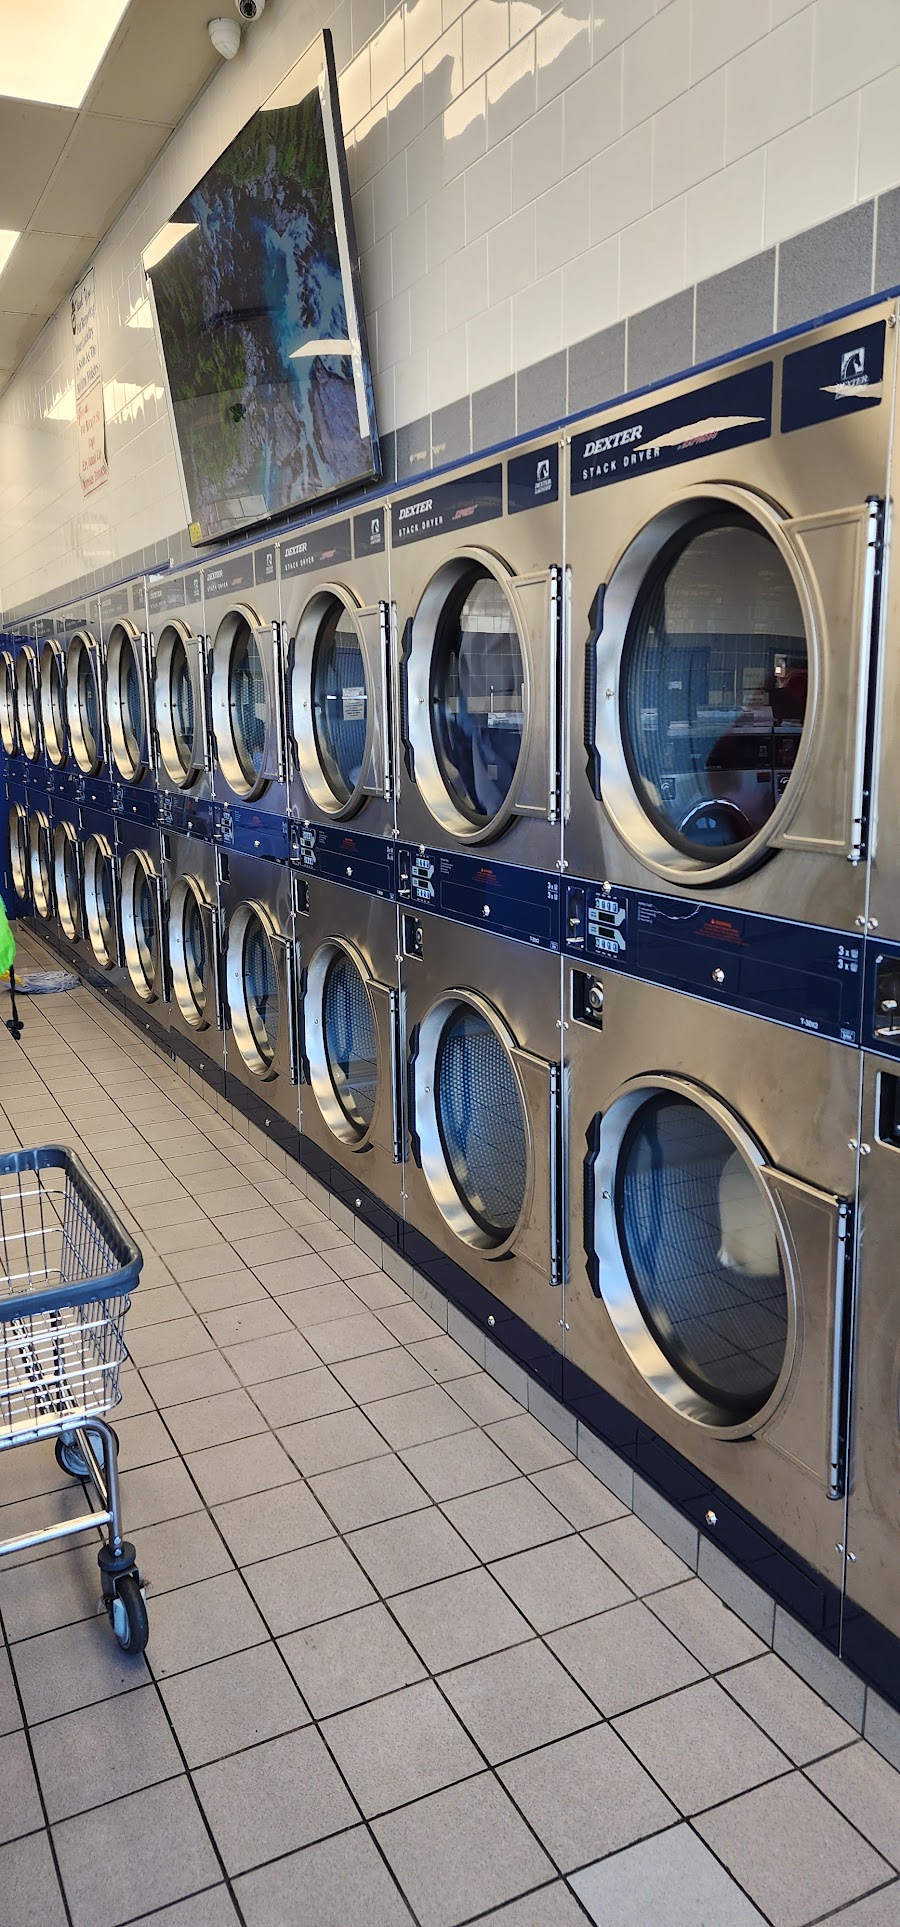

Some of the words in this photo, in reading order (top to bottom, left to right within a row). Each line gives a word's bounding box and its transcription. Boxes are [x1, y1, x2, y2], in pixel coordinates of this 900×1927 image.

[583, 425, 643, 458] DEXTER
[582, 460, 617, 480] STACK
[623, 447, 660, 468] DRYER
[398, 499, 433, 521] DEXTER
[398, 521, 419, 538] STACK
[422, 515, 443, 531] DRYER
[284, 542, 307, 558] DEXTER
